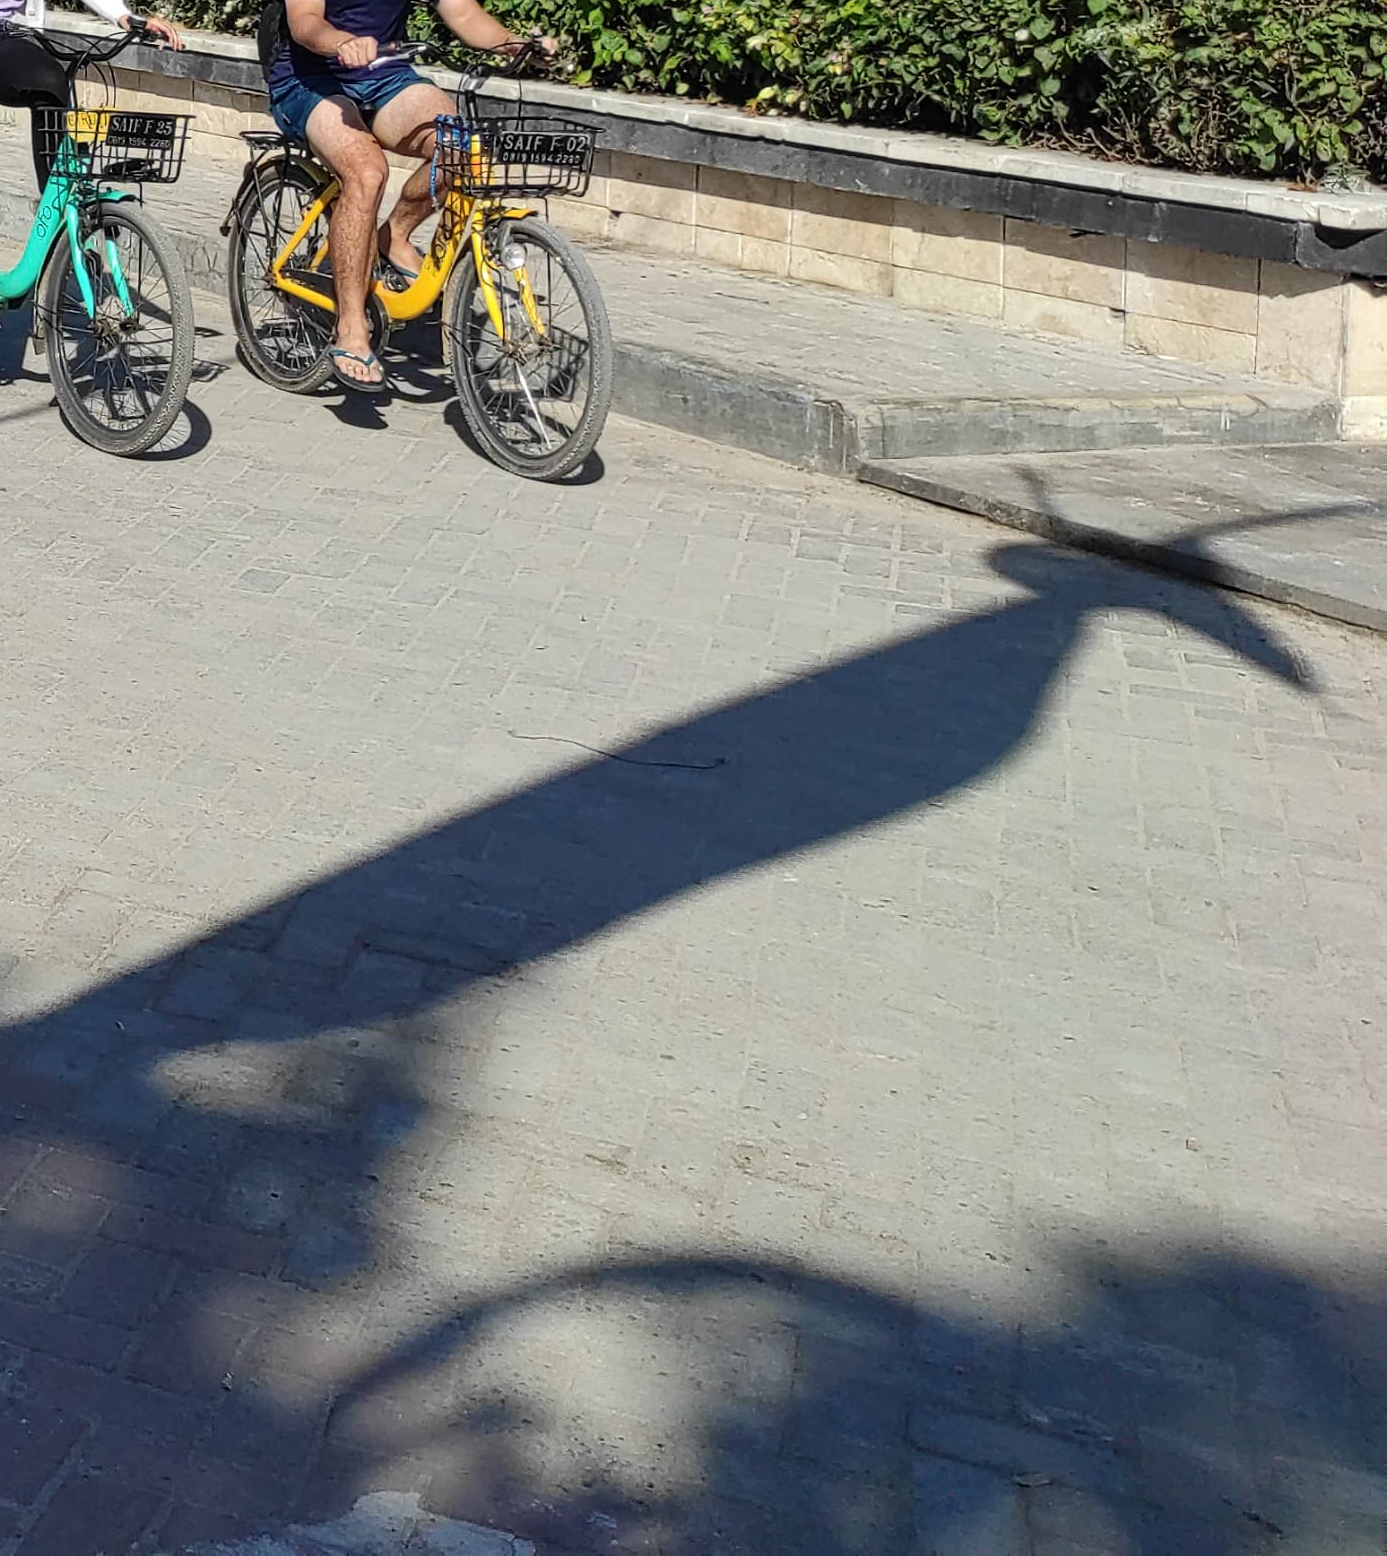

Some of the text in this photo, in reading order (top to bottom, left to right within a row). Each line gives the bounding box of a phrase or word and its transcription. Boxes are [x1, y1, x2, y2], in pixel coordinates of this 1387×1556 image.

[111, 116, 144, 134] SAIF
[143, 119, 155, 135] F
[155, 120, 174, 136] 25
[503, 134, 587, 153] SAIF F 02
